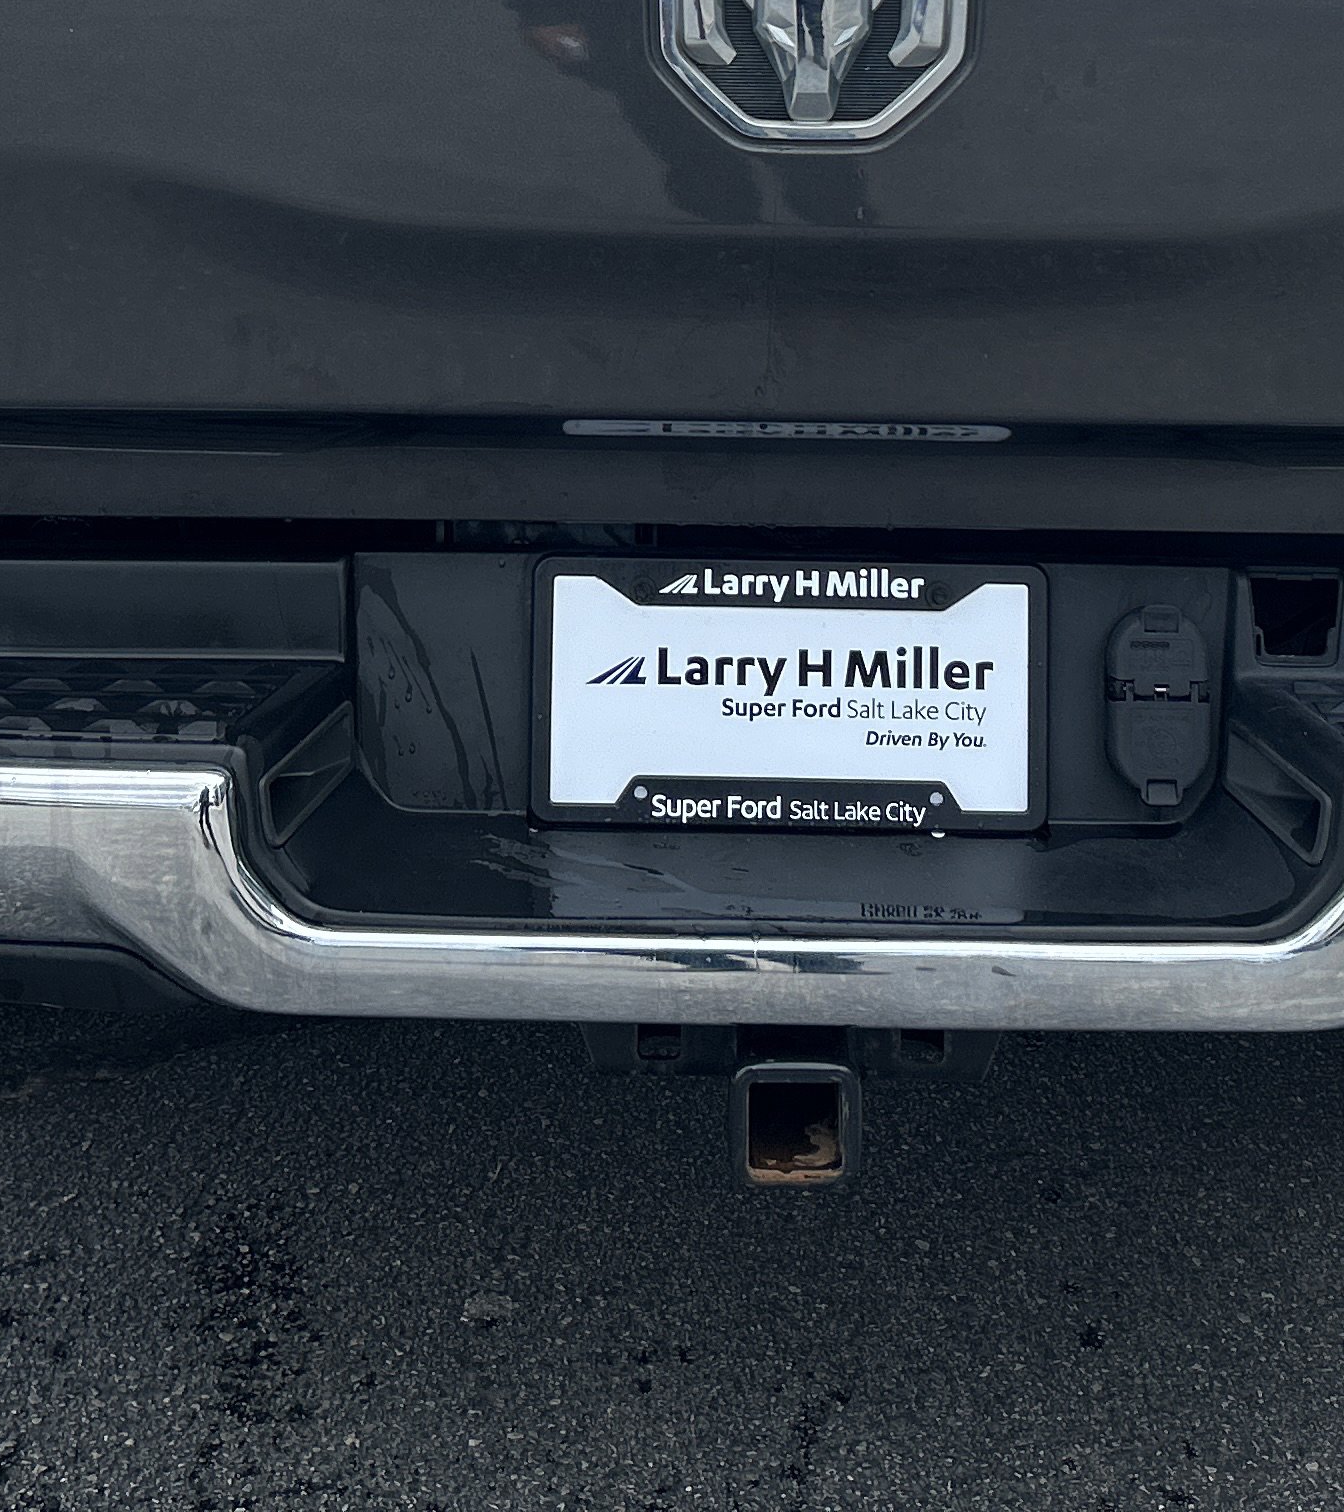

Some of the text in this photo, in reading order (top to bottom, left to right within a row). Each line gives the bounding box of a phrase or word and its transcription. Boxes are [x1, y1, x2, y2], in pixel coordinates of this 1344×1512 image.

[703, 567, 925, 603] Larry H Miller
[657, 645, 994, 697] Larry H Miller
[721, 698, 987, 726] Super Ford Salt Lake City
[865, 730, 923, 747] Driven
[928, 732, 950, 751] By
[651, 794, 927, 827] Super Ford Salt Lake City
